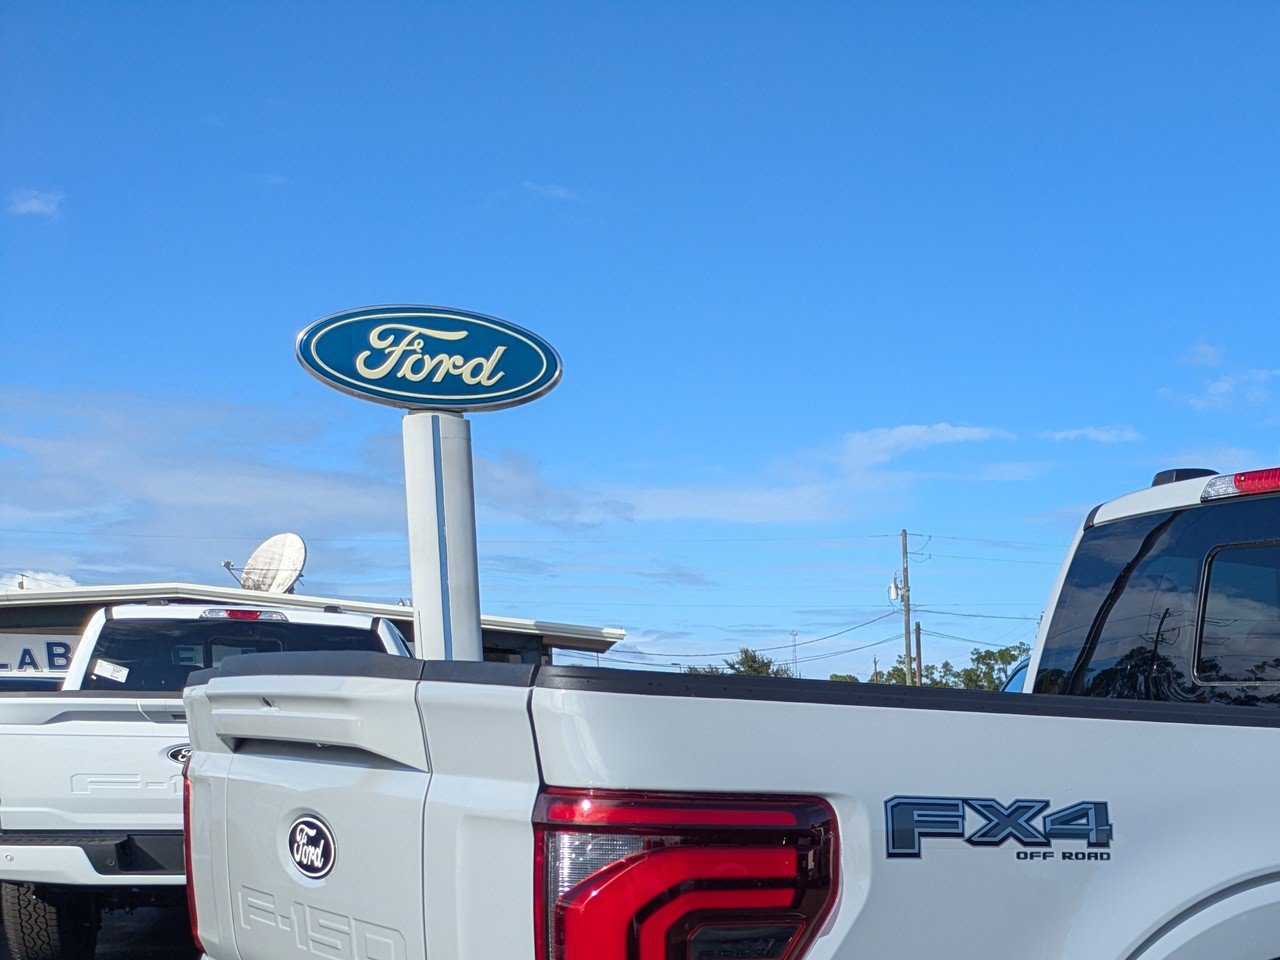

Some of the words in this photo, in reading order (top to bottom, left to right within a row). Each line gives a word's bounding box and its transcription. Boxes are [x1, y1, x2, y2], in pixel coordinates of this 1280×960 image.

[356, 323, 507, 386] Ford
[294, 824, 324, 868] Ford
[883, 795, 1114, 860] FX4
[1016, 851, 1055, 861] OFF
[1061, 851, 1112, 861] ROAD
